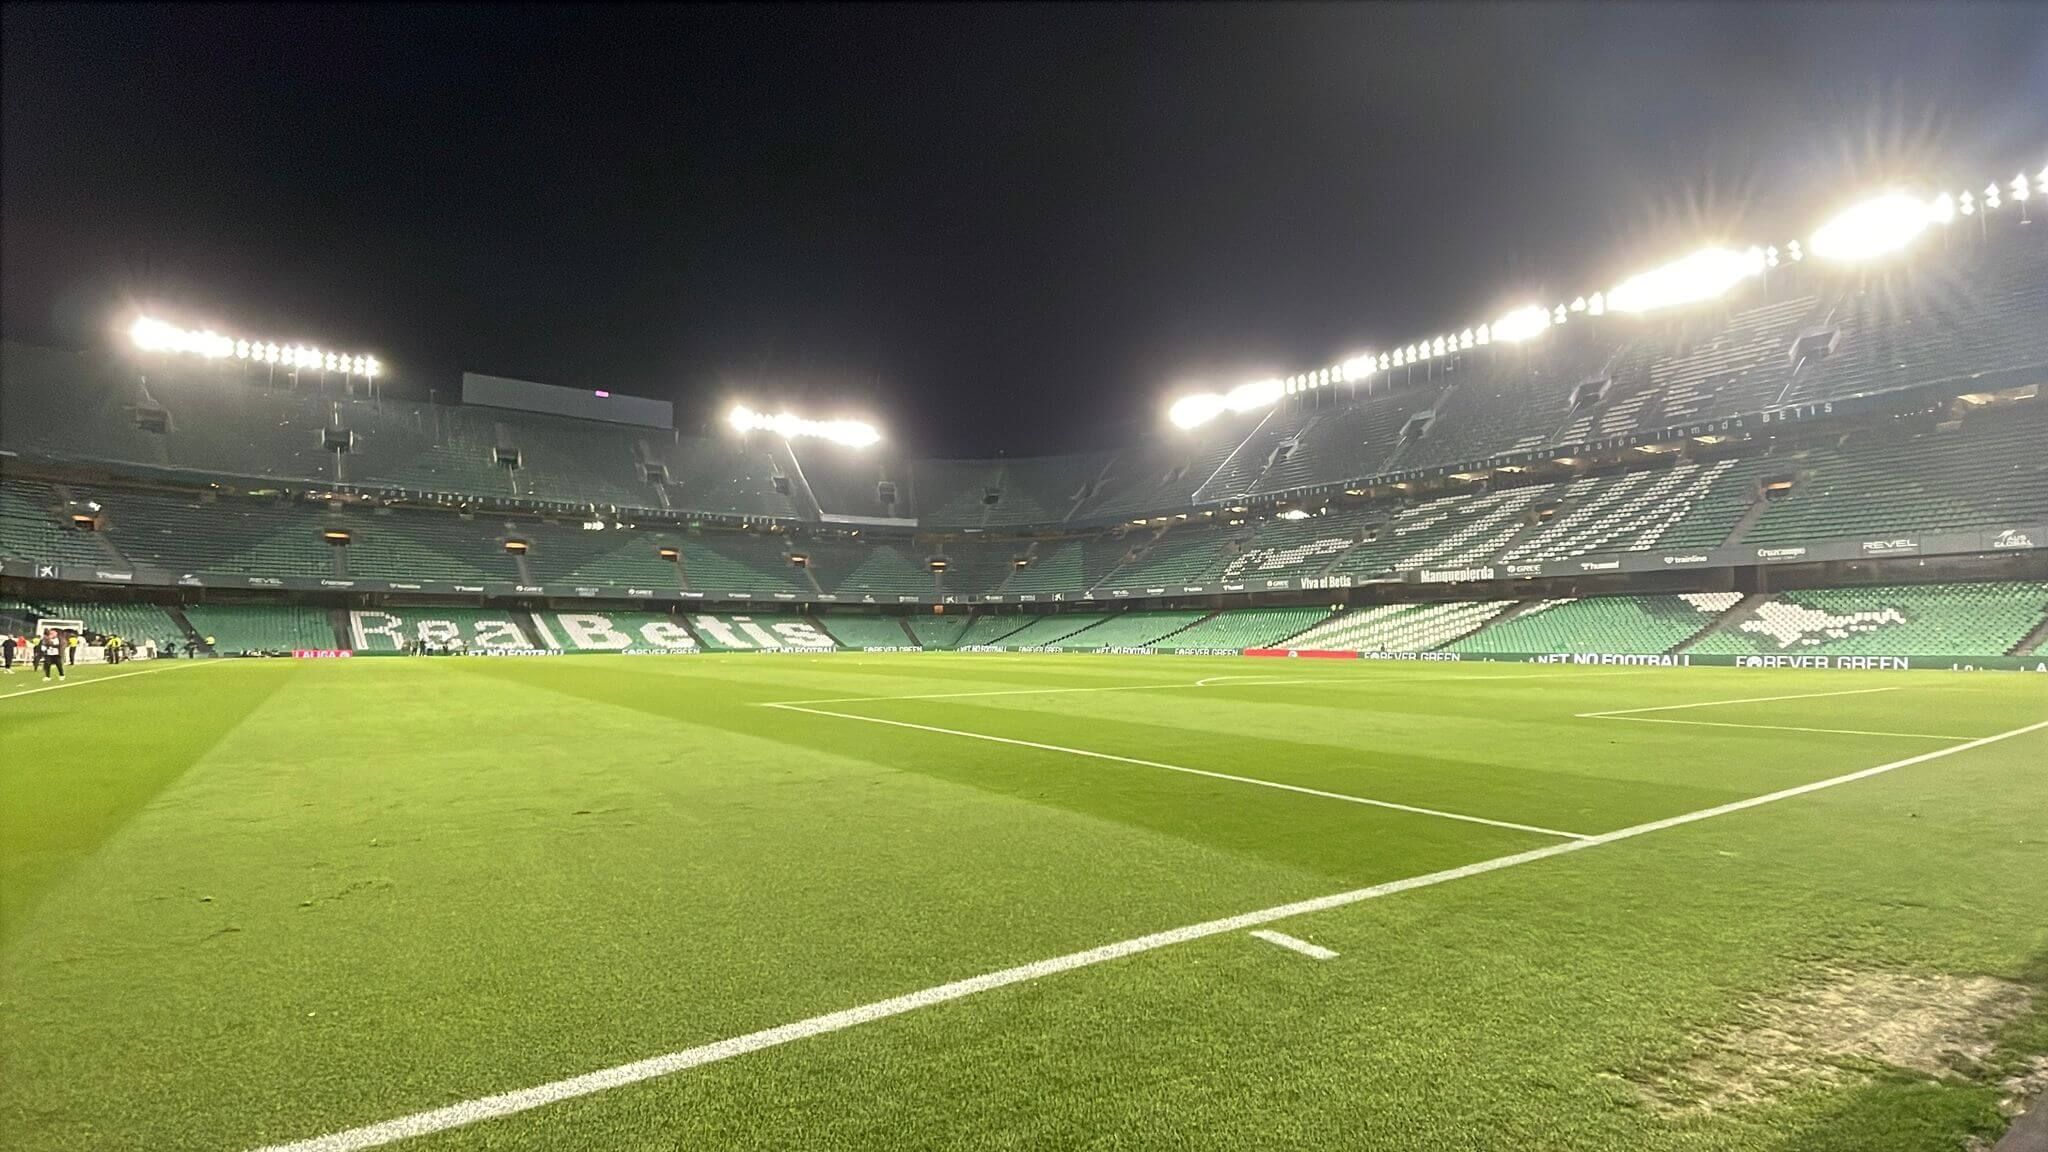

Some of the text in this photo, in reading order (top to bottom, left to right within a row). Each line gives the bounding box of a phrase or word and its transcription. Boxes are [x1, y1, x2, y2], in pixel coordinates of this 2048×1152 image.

[1762, 403, 1833, 423] BETIS
[1863, 539, 1919, 550] REVEL
[1420, 565, 1494, 583] Manquepierda
[1300, 575, 1352, 589] Viva el Betis
[350, 610, 838, 651] Real Betis
[1364, 651, 1461, 662] FOREVER GREEN
[1573, 653, 1599, 664] NO
[1735, 655, 1909, 670] FOREVER GREEN
